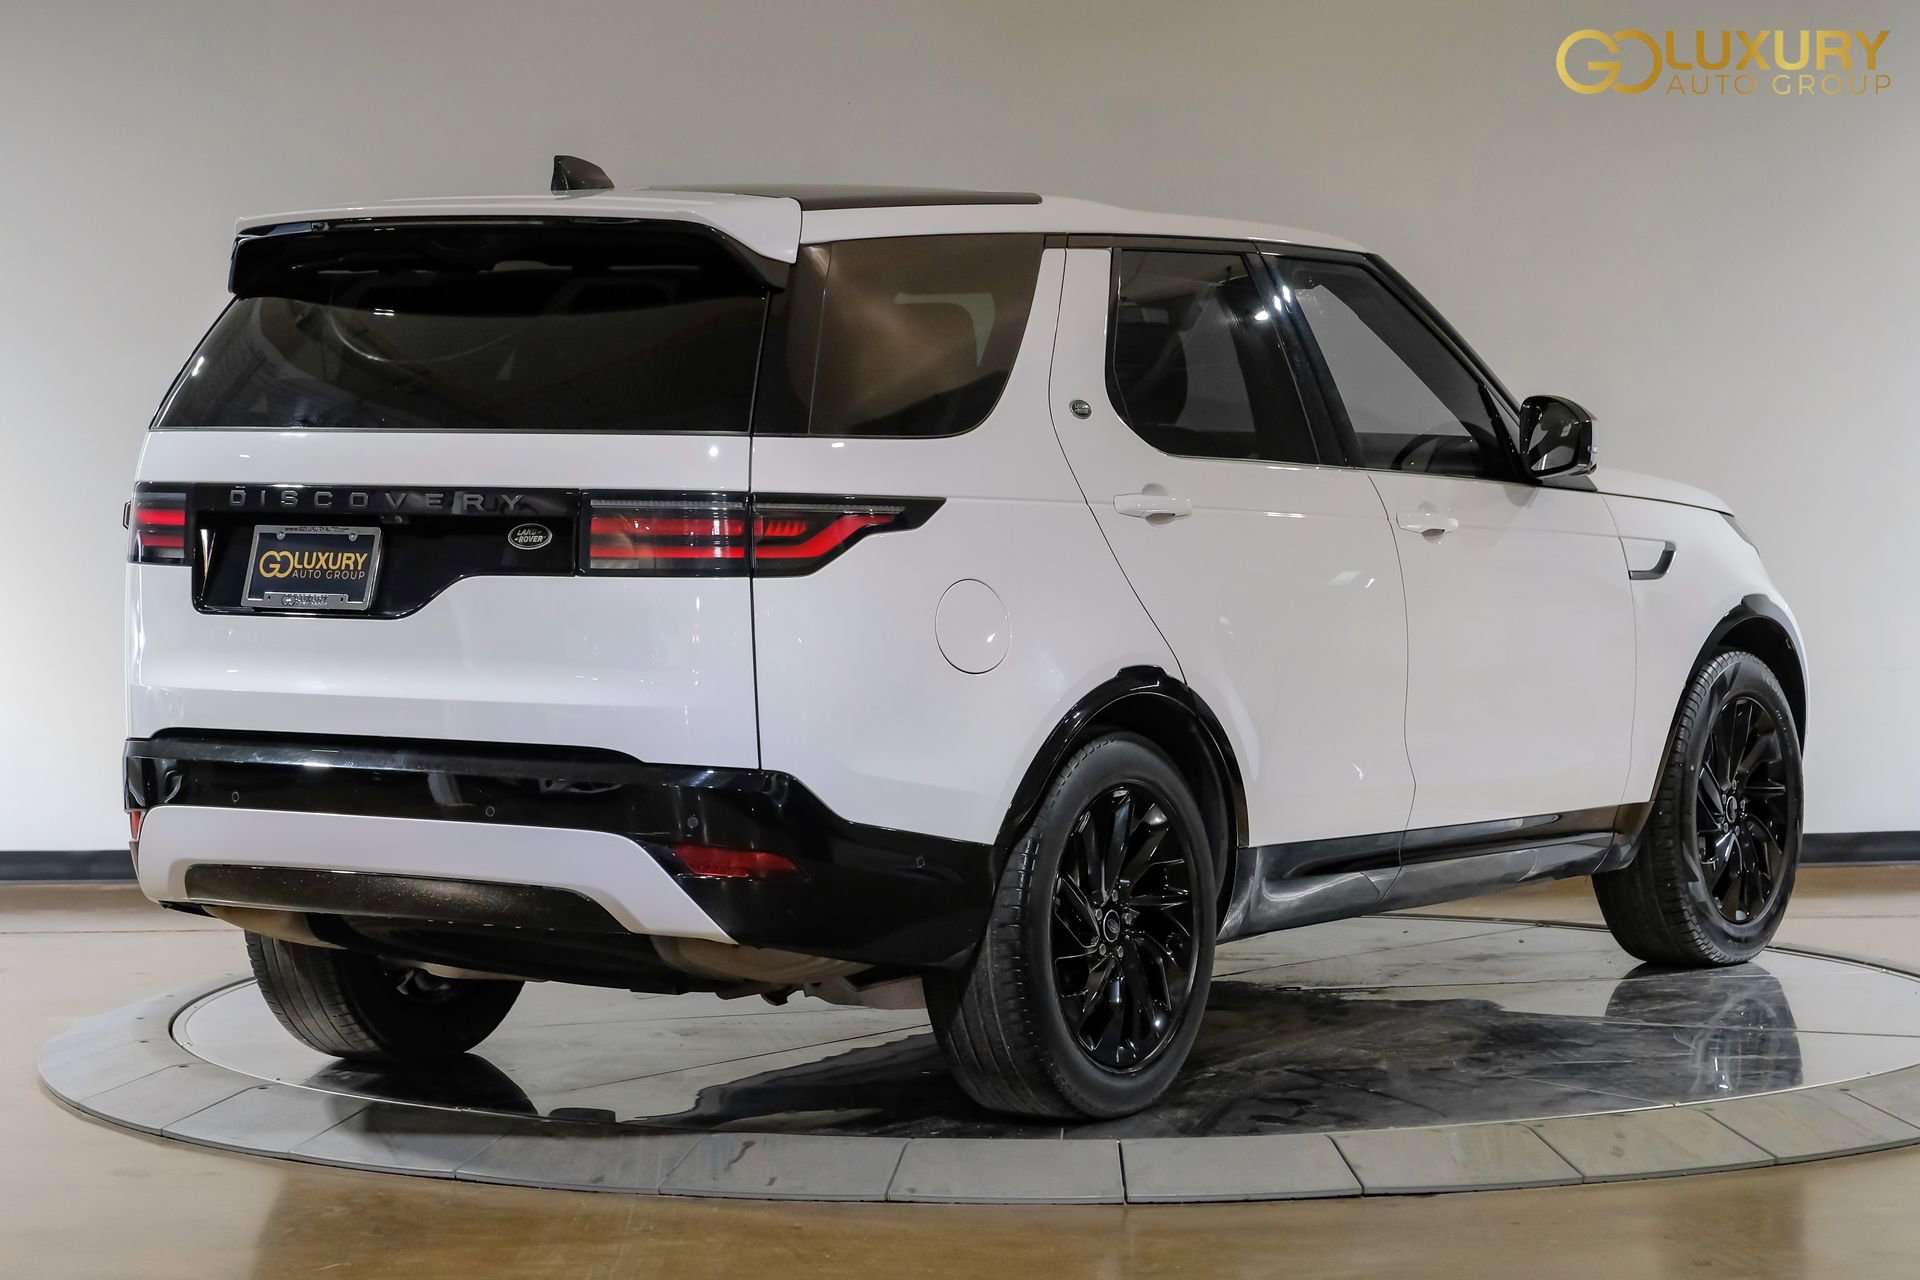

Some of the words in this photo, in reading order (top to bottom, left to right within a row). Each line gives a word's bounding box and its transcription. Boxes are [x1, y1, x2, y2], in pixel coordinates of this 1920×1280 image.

[230, 489, 525, 511] DISCOVERY
[518, 535, 544, 543] ROVER
[294, 551, 368, 570] LUXURY
[292, 569, 322, 579] AUTO
[326, 570, 365, 580] GROUP
